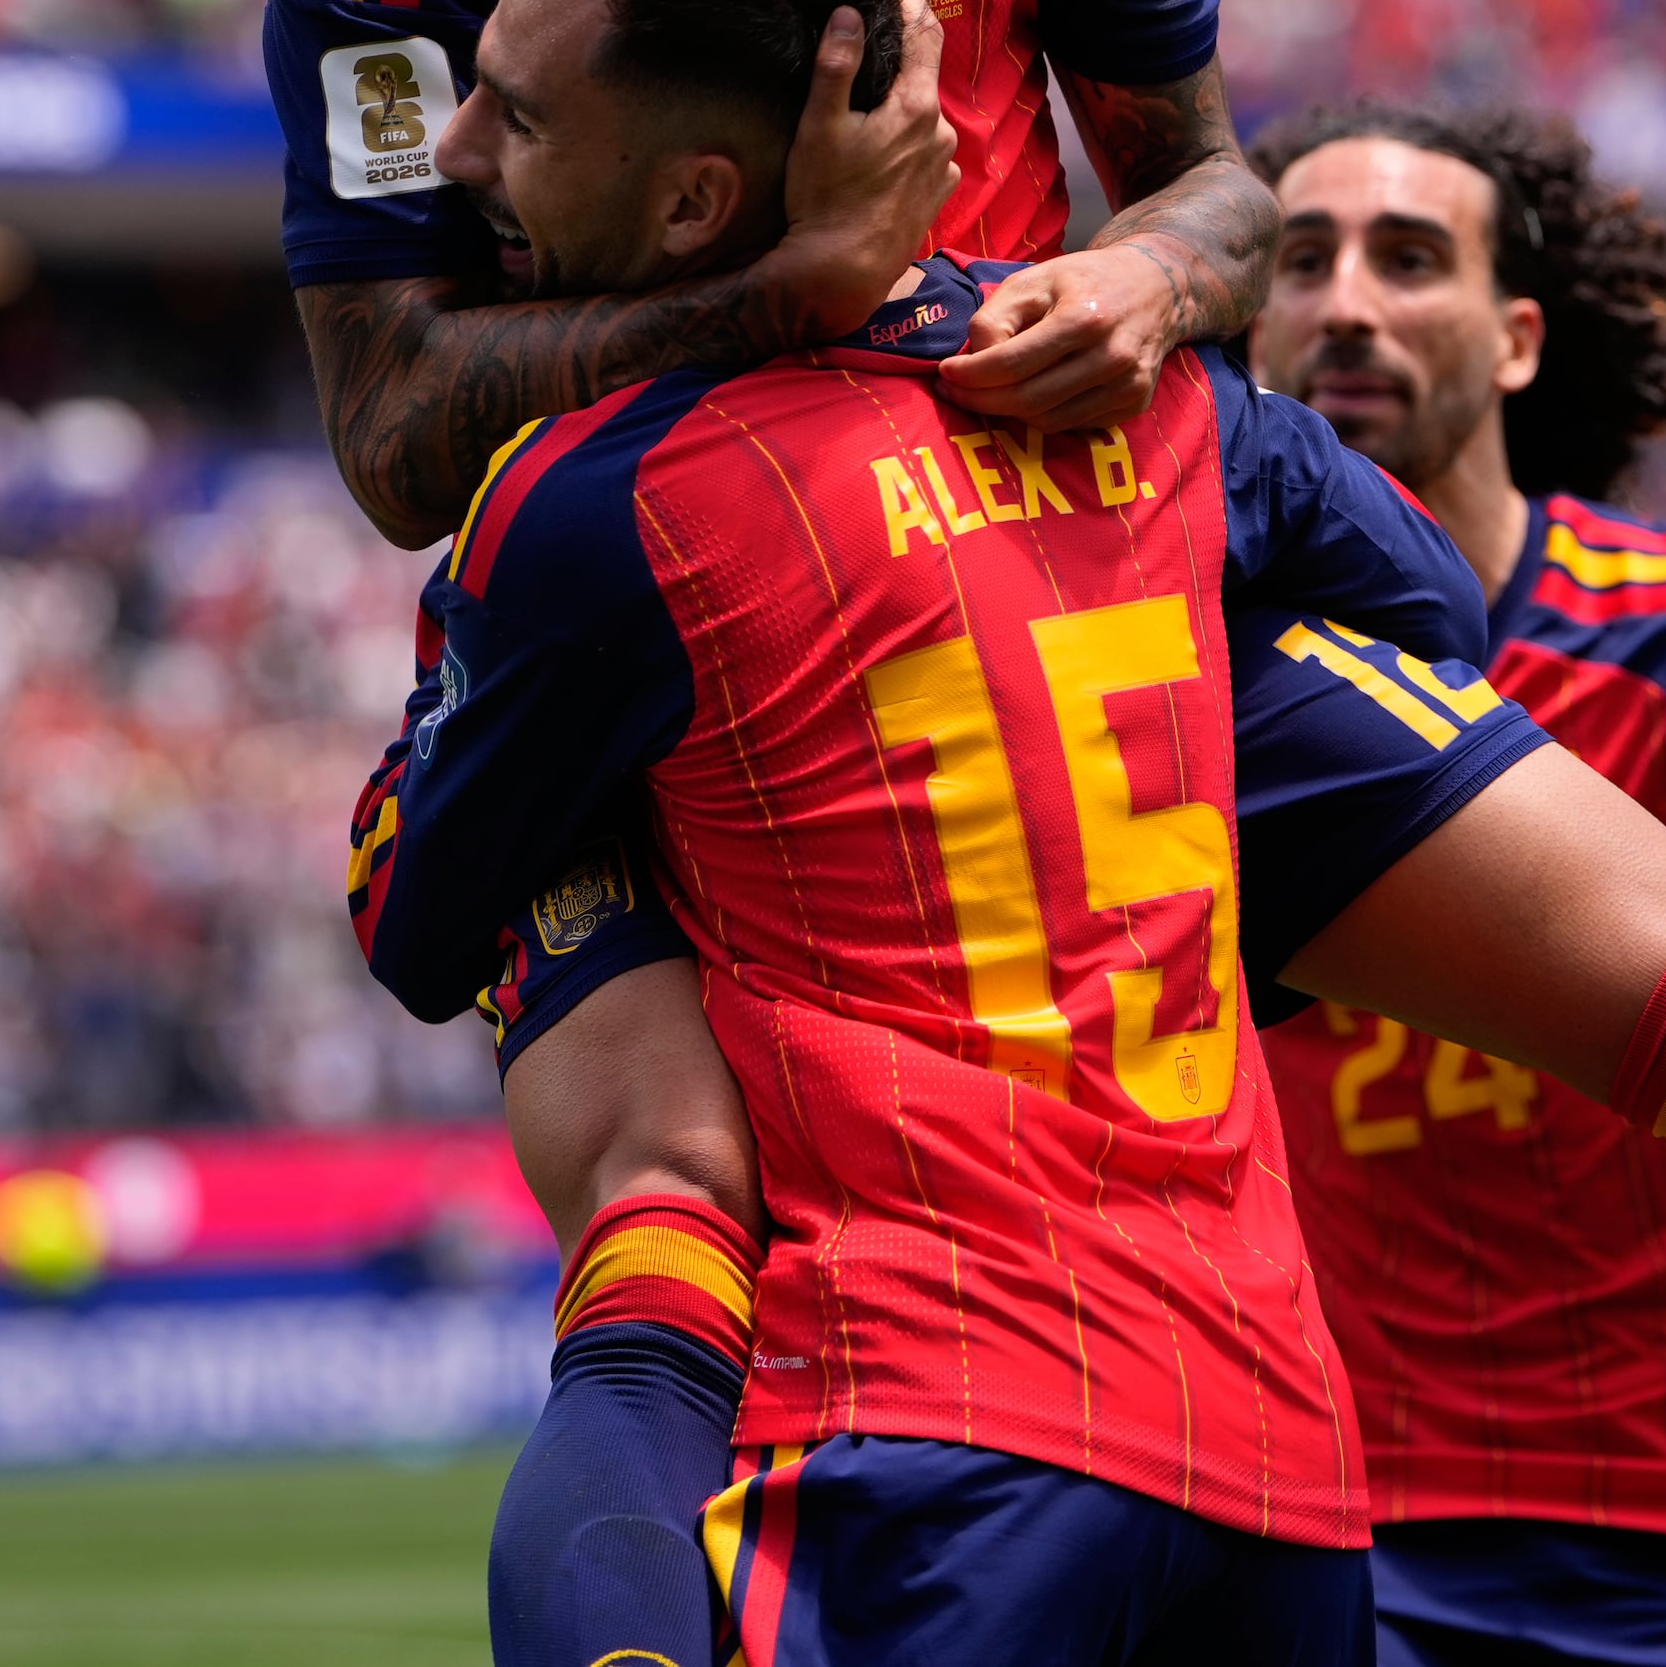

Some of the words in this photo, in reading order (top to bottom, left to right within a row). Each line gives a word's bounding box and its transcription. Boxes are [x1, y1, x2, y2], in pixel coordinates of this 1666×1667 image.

[380, 130, 410, 144] FIFA
[365, 155, 405, 168] WORLD
[406, 151, 429, 163] CUP
[366, 162, 431, 184] 2026
[868, 303, 948, 346] España
[870, 425, 1075, 558] ALEX
[1088, 424, 1157, 507] B.
[864, 592, 1237, 1123] 15
[1323, 996, 1540, 1156] 24
